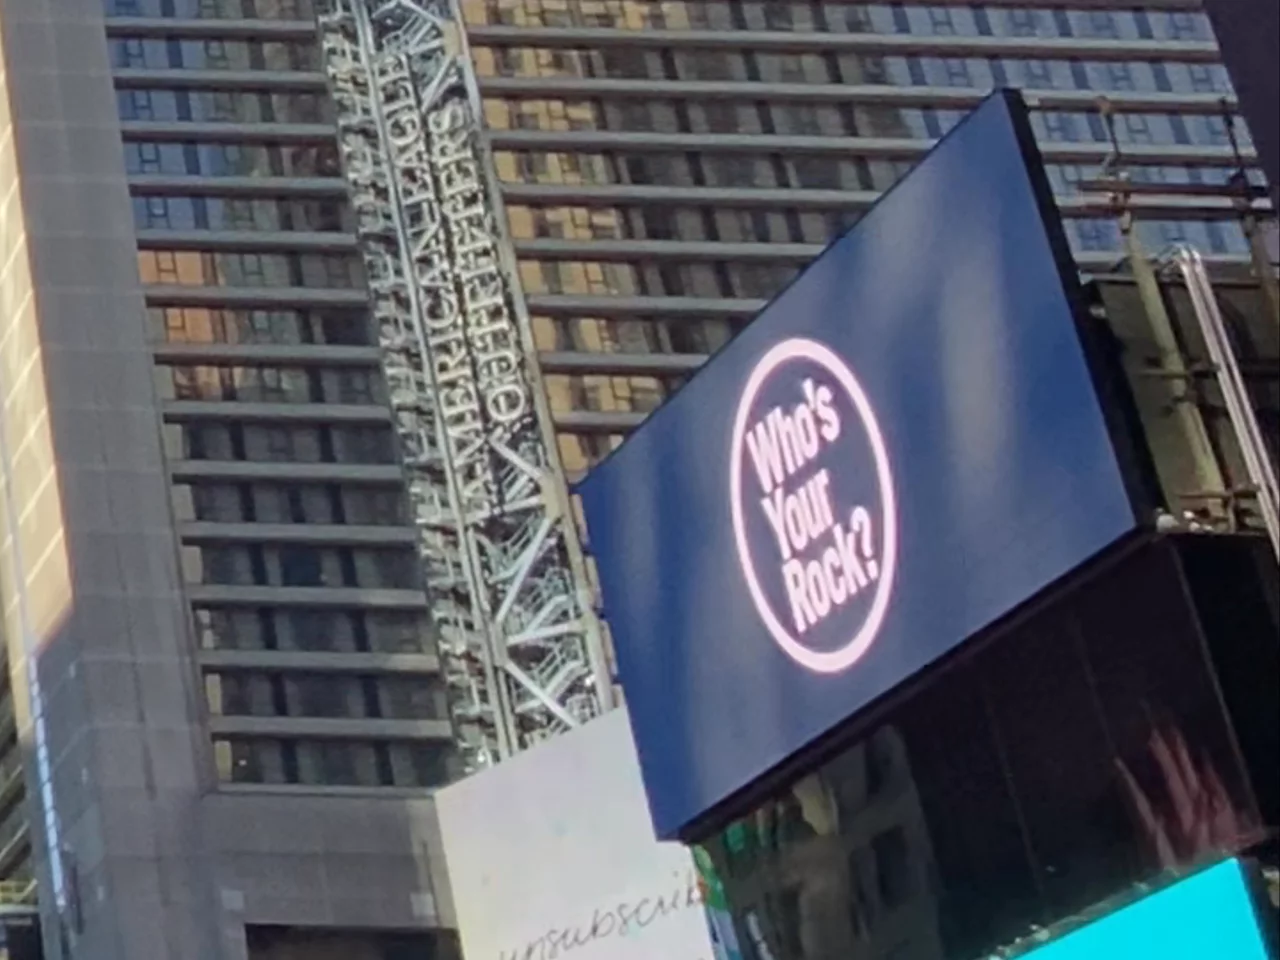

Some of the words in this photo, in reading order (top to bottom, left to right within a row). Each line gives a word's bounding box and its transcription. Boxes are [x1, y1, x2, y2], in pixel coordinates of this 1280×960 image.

[374, 53, 437, 207] EAGLE
[428, 103, 526, 421] OUTFITTERS
[408, 222, 498, 506] AMERICAN
[745, 377, 840, 493] Who's
[760, 467, 834, 560] Your
[782, 505, 878, 633] Rock?
